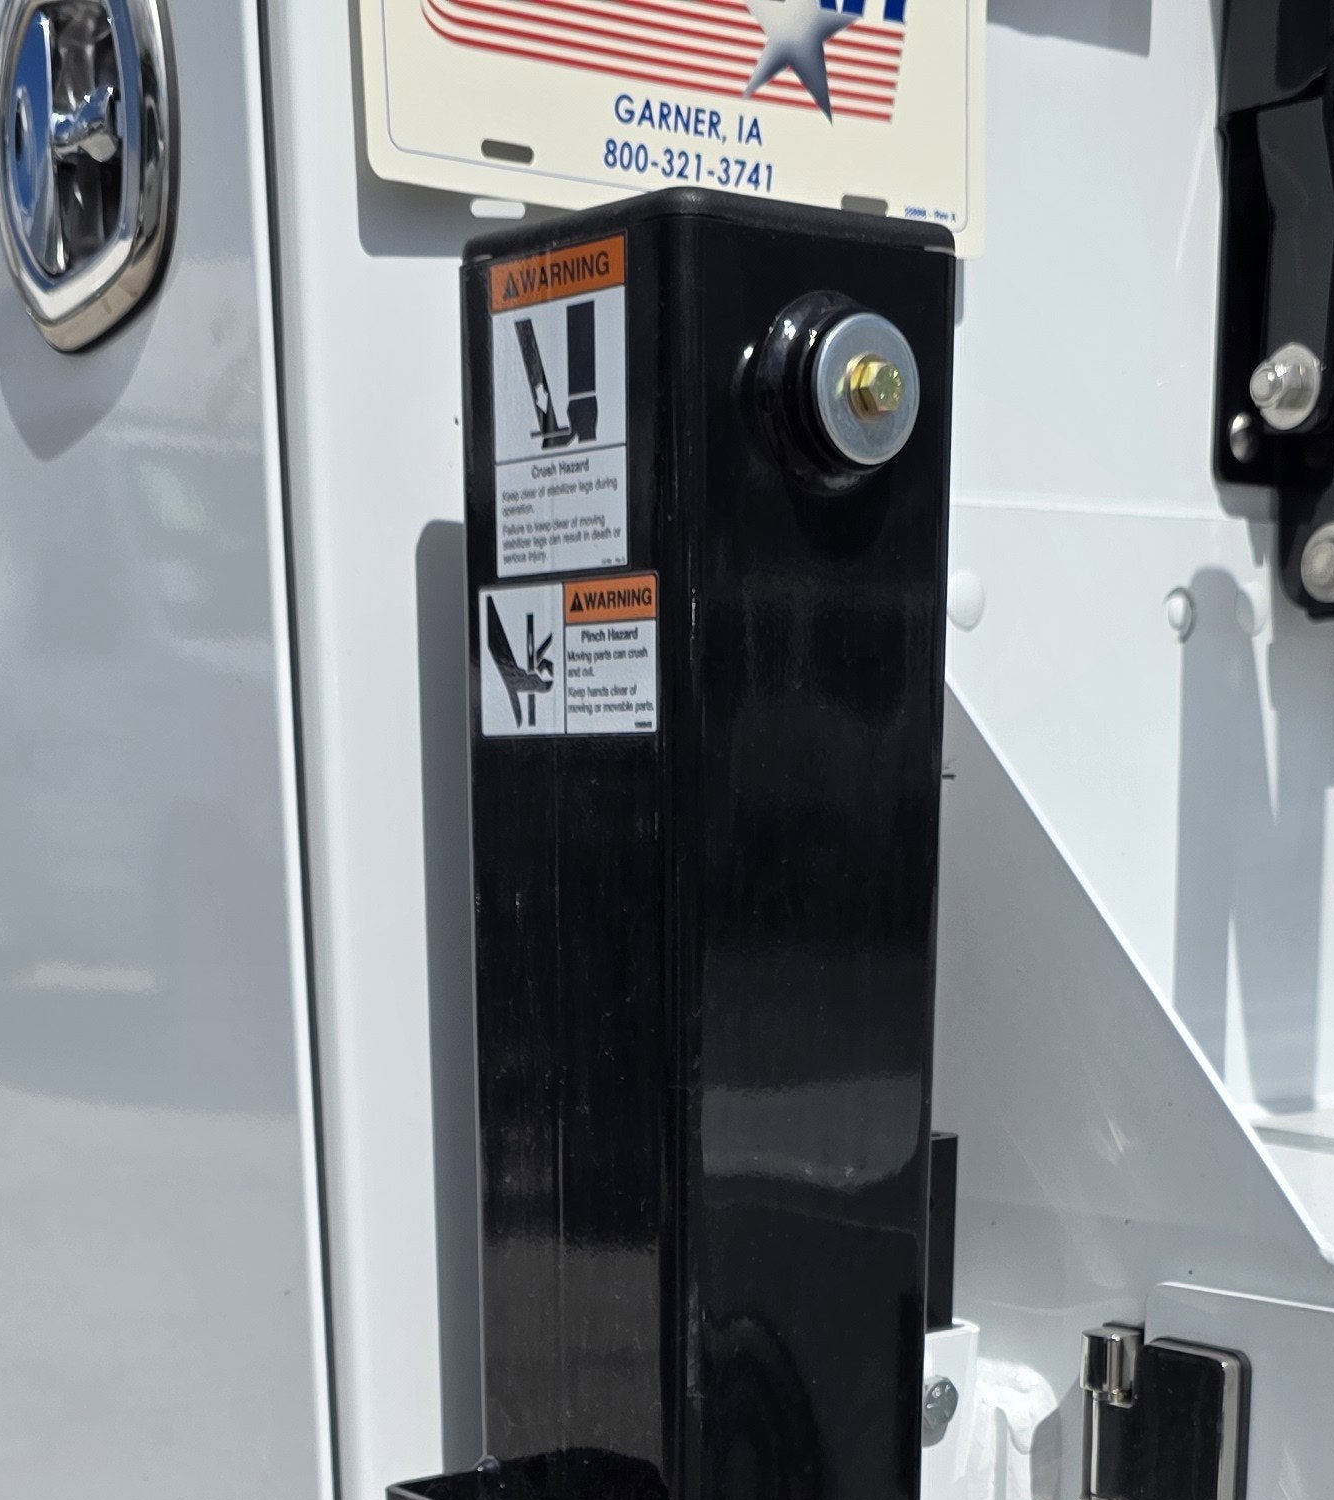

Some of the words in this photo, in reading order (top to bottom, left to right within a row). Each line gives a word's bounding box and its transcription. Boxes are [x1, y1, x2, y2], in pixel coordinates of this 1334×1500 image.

[614, 94, 727, 144] GARNER,
[737, 114, 762, 147] IA
[603, 138, 773, 193] 800-321-3741
[520, 251, 610, 292] WARNING
[531, 463, 557, 479] Crush
[558, 458, 590, 476] Hazard
[583, 587, 652, 609] WARNING
[581, 628, 606, 643] Pinch
[607, 626, 638, 642] Hazard
[568, 650, 593, 664] Moving
